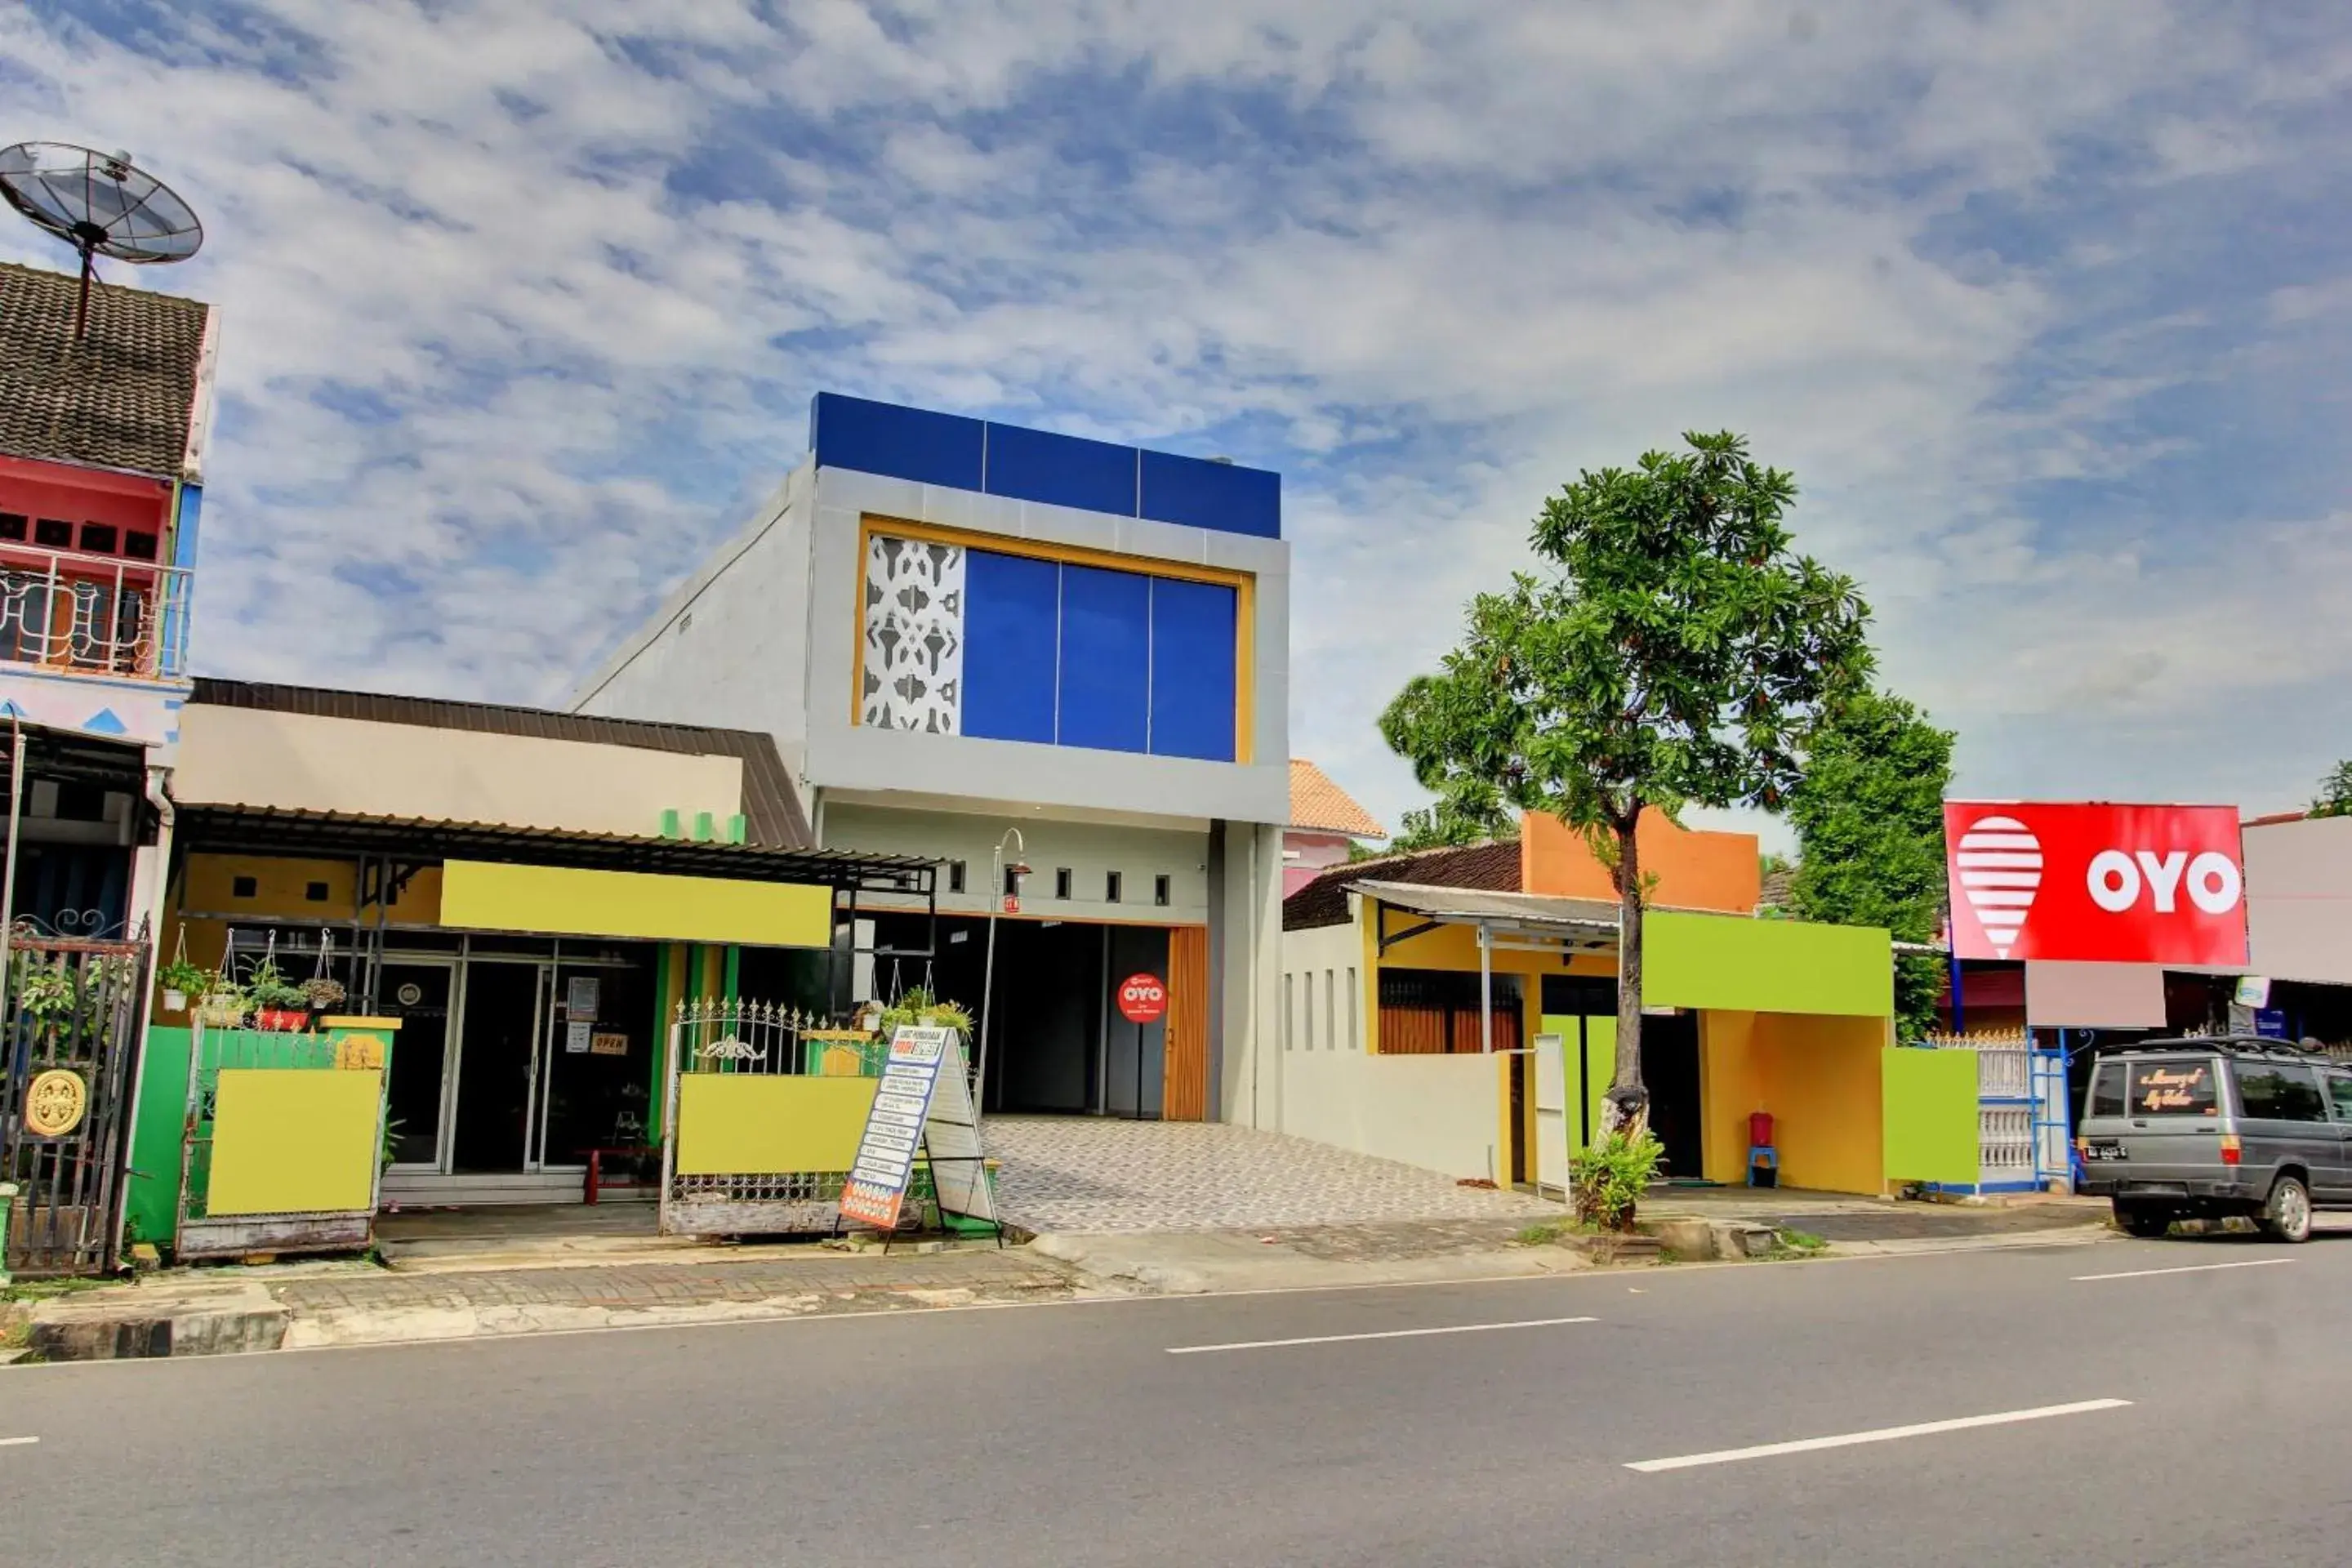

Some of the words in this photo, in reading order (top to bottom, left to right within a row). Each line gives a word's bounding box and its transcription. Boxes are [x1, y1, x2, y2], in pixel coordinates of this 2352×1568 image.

[2087, 849, 2241, 914] OYO
[1124, 987, 1163, 1001] OYO
[597, 1037, 622, 1049] OPEN
